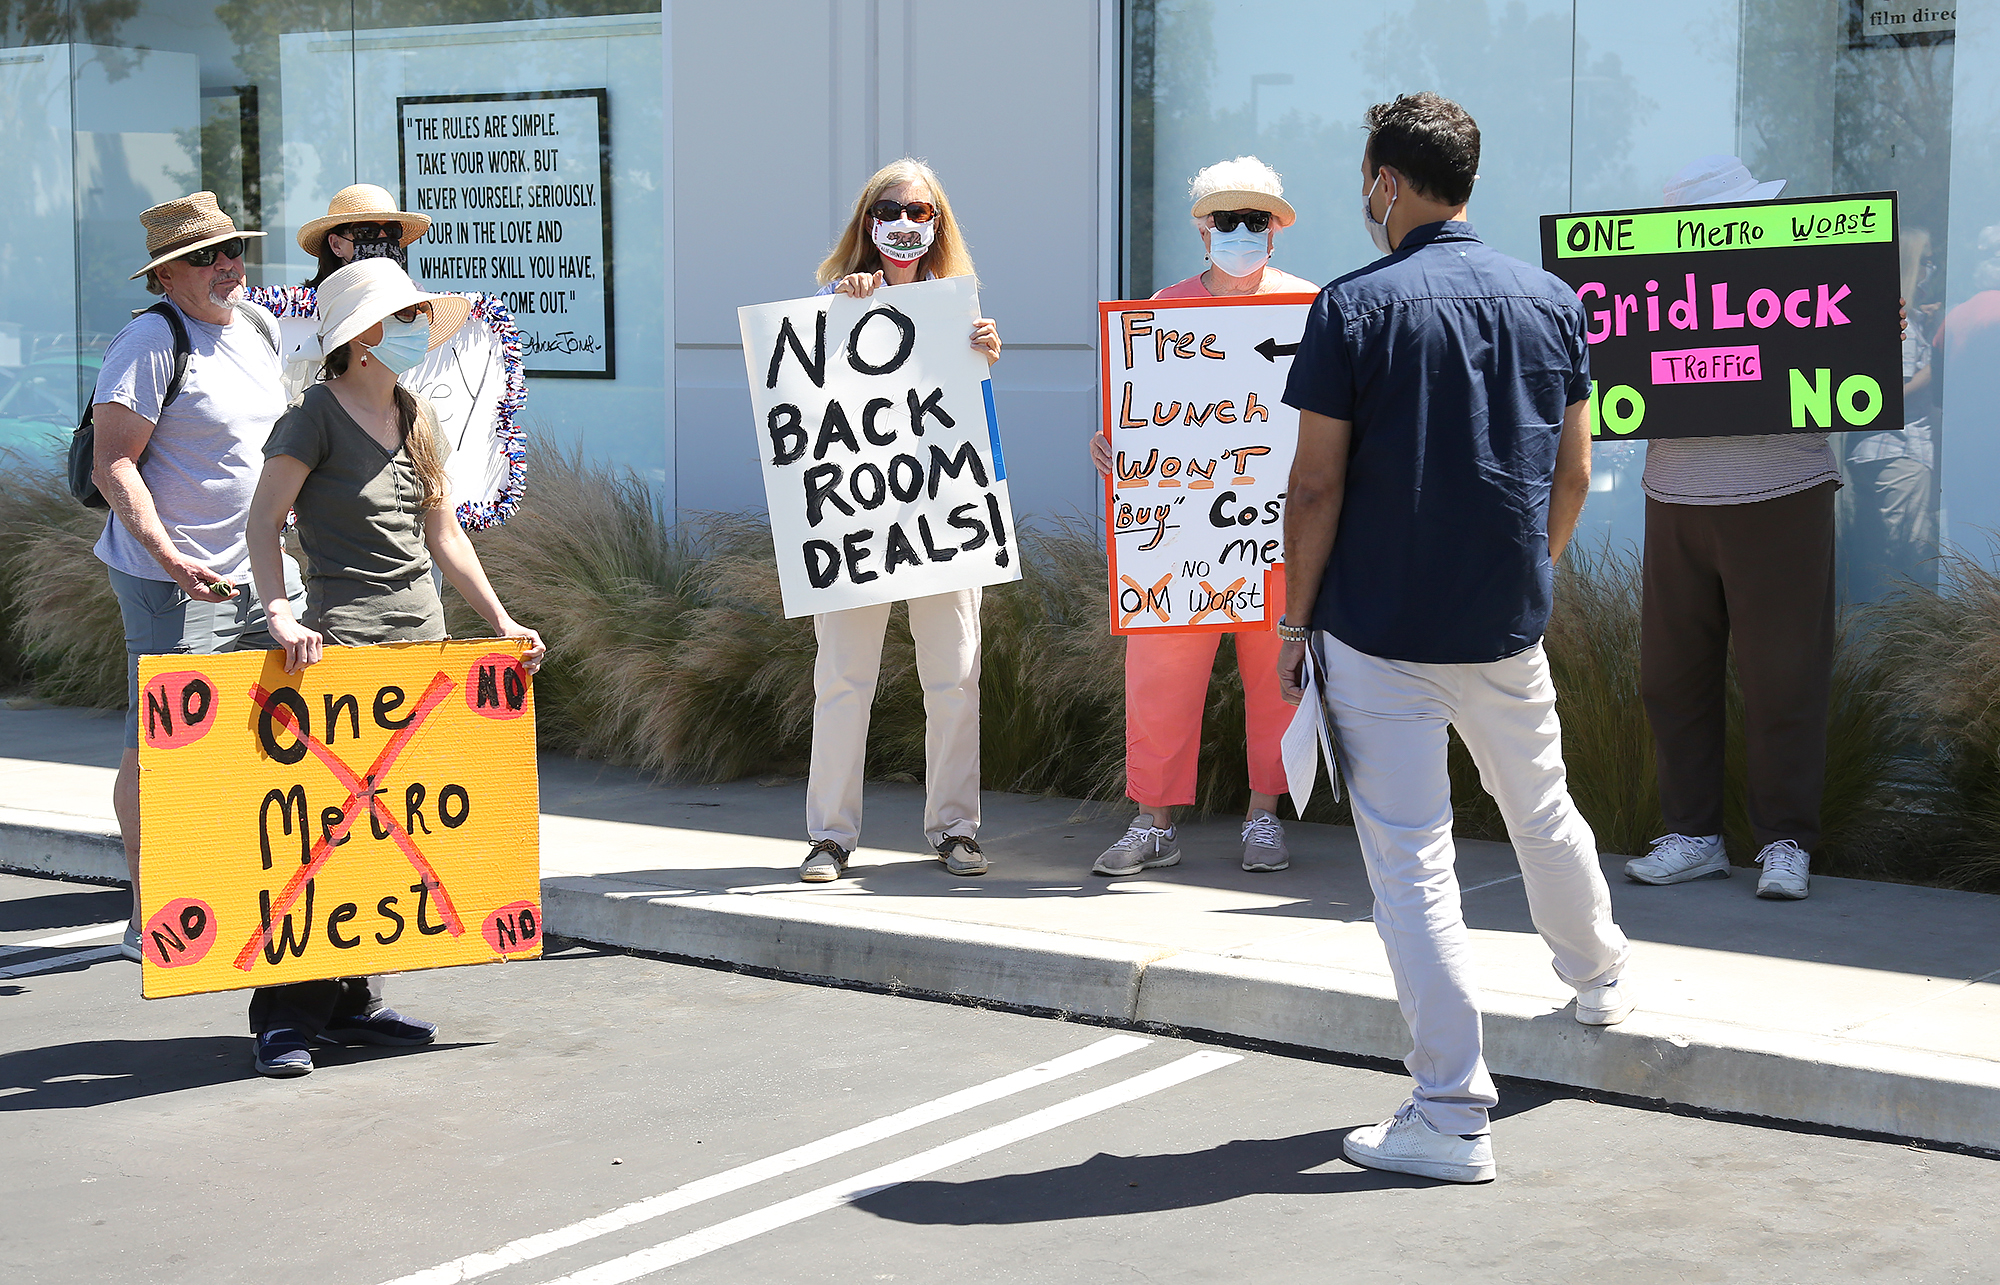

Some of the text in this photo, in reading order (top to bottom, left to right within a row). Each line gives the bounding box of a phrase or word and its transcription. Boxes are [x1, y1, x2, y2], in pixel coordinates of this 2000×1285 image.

[1870, 11, 1906, 26] film
[442, 116, 480, 140] RULES
[484, 115, 508, 138] ARE
[512, 113, 559, 137] SIMPLE.
[416, 152, 447, 175] TAKE
[451, 151, 484, 174] YOUR
[534, 149, 559, 172] BUT
[417, 184, 596, 210] NEVER YOURSELF, SERIOUSLY.
[457, 222, 469, 245] IN
[472, 221, 497, 244] THE
[500, 221, 532, 244] LOVE
[536, 220, 563, 243] AND
[1567, 219, 1635, 252] ONE
[419, 255, 596, 281] WHATEVER SKILL YOU HAVE,
[766, 303, 915, 389] NO
[1121, 311, 1225, 370] Free
[1789, 368, 1883, 428] NO
[767, 387, 955, 467] BACK
[803, 441, 988, 528] ROOM
[802, 492, 1009, 589] DEALS!
[1181, 560, 1210, 578] NO
[1121, 585, 1171, 614] OM
[147, 678, 211, 739] NO
[477, 665, 525, 711] NO
[258, 685, 416, 765] One
[151, 906, 206, 963] NO
[259, 873, 446, 965] West
[496, 909, 536, 950] NO
